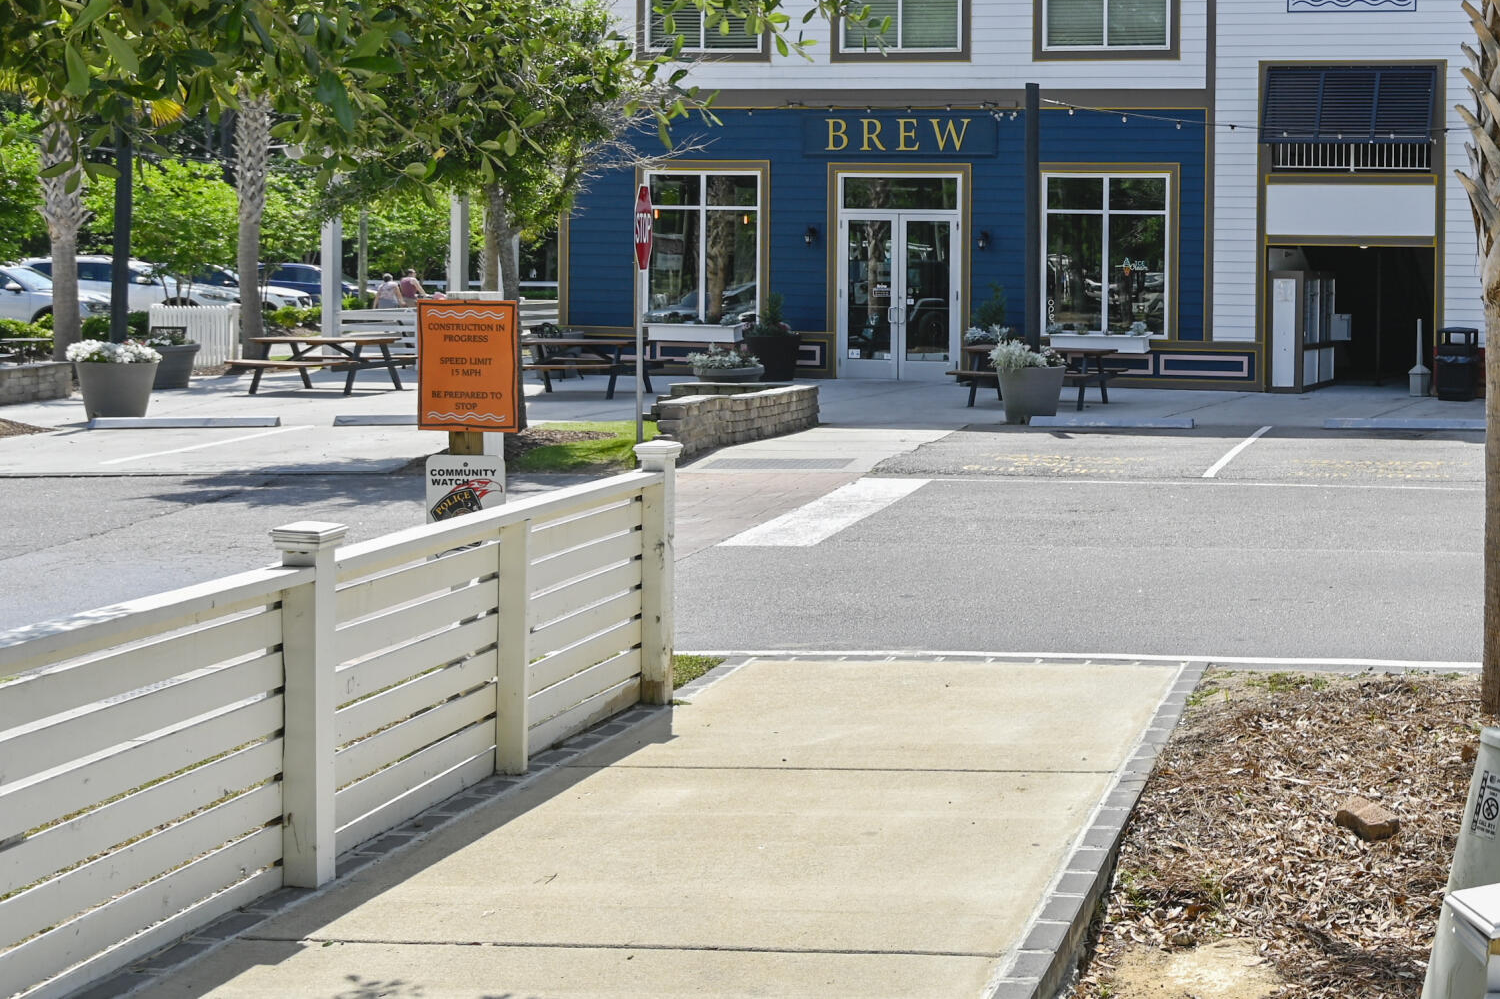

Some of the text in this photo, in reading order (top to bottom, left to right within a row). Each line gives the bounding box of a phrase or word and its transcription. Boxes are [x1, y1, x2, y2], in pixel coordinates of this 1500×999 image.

[825, 118, 972, 151] BREW
[635, 212, 652, 243] STOP
[428, 323, 505, 332] CONSTRUCTION IN
[443, 334, 489, 343] PROGRESS
[439, 356, 493, 365] SPEED LIMIT
[451, 368, 481, 377] 15 MPH
[431, 390, 502, 400] BE PREPARED TO
[455, 402, 478, 410] STOP
[430, 469, 497, 477] COMMUNITY
[431, 478, 470, 486] WATCH
[435, 491, 471, 515] POLICE
